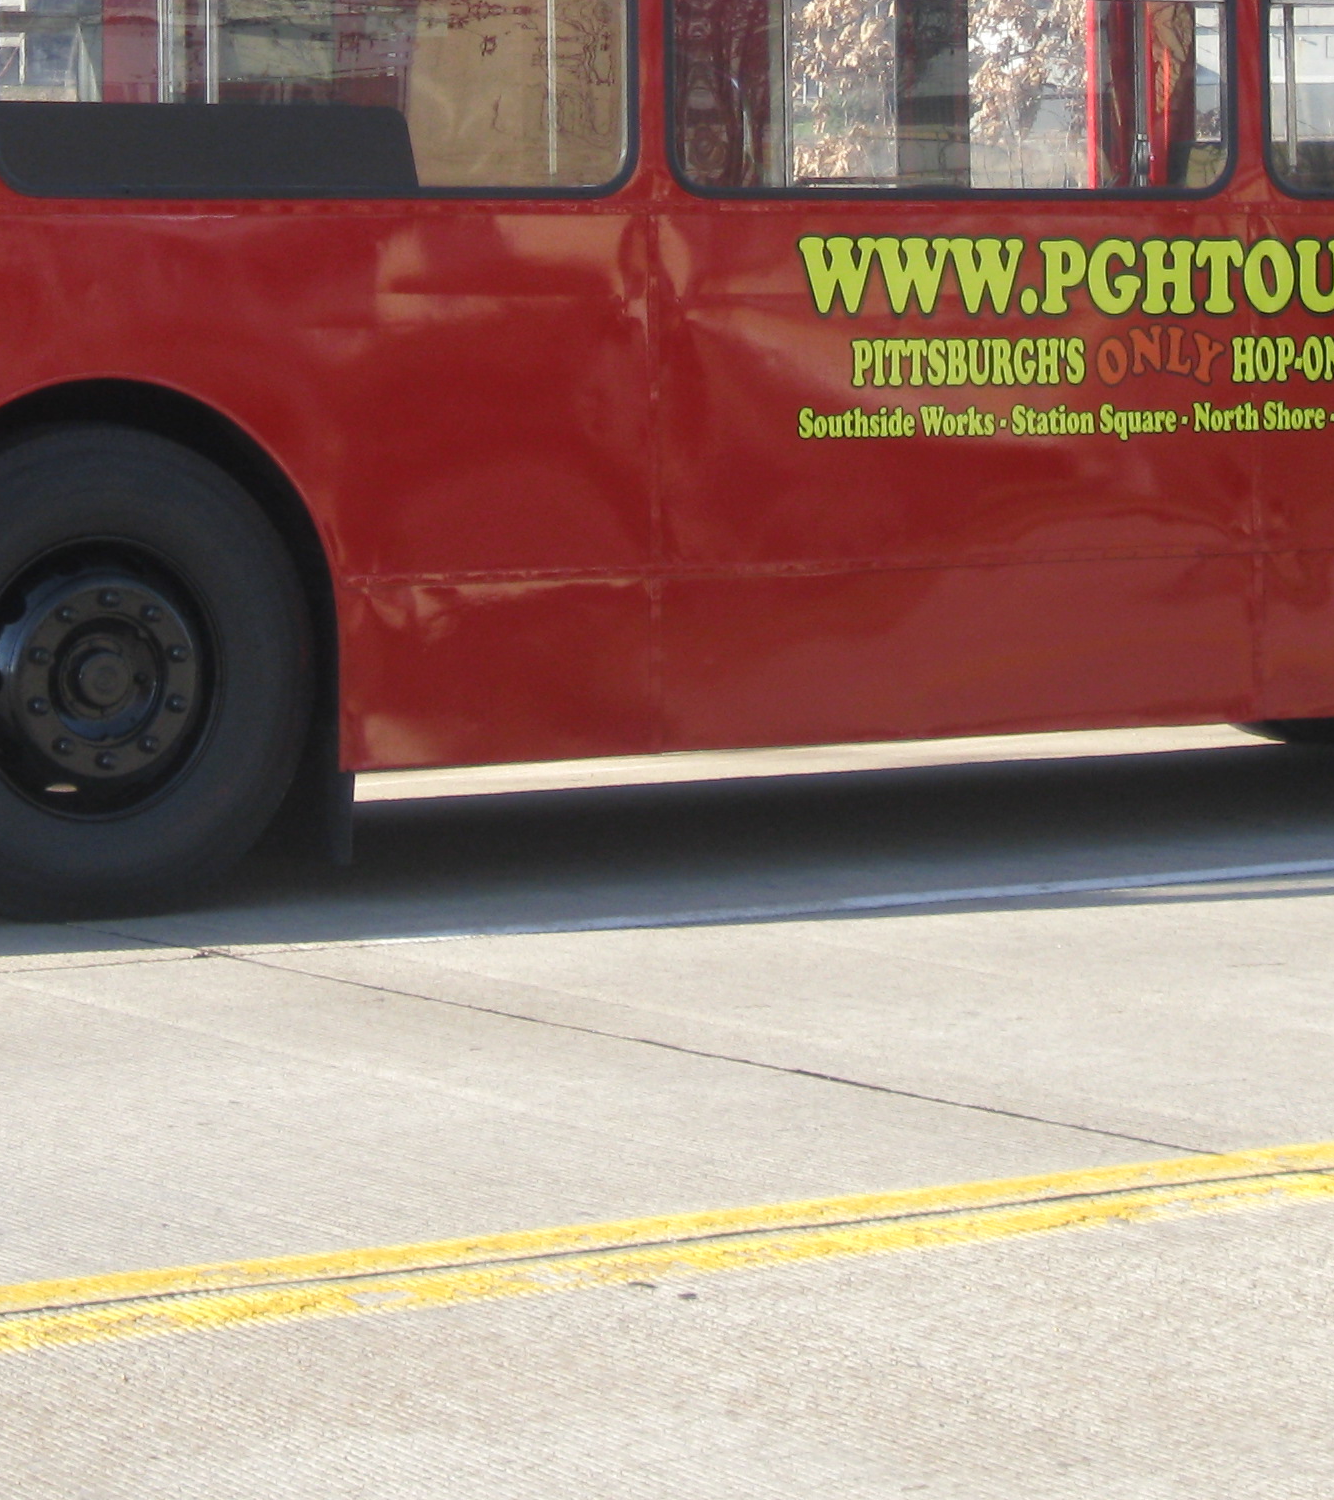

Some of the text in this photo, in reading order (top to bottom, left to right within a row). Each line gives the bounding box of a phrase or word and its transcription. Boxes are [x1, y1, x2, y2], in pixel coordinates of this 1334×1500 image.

[852, 338, 1085, 387] PITTSBURGH'S
[1096, 325, 1226, 385] ONLY
[799, 407, 916, 439] Southside
[920, 406, 995, 437] Works
[1011, 404, 1095, 436] Station
[1099, 403, 1177, 441] Square
[1193, 402, 1259, 432] North
[1263, 401, 1326, 431] Shore
